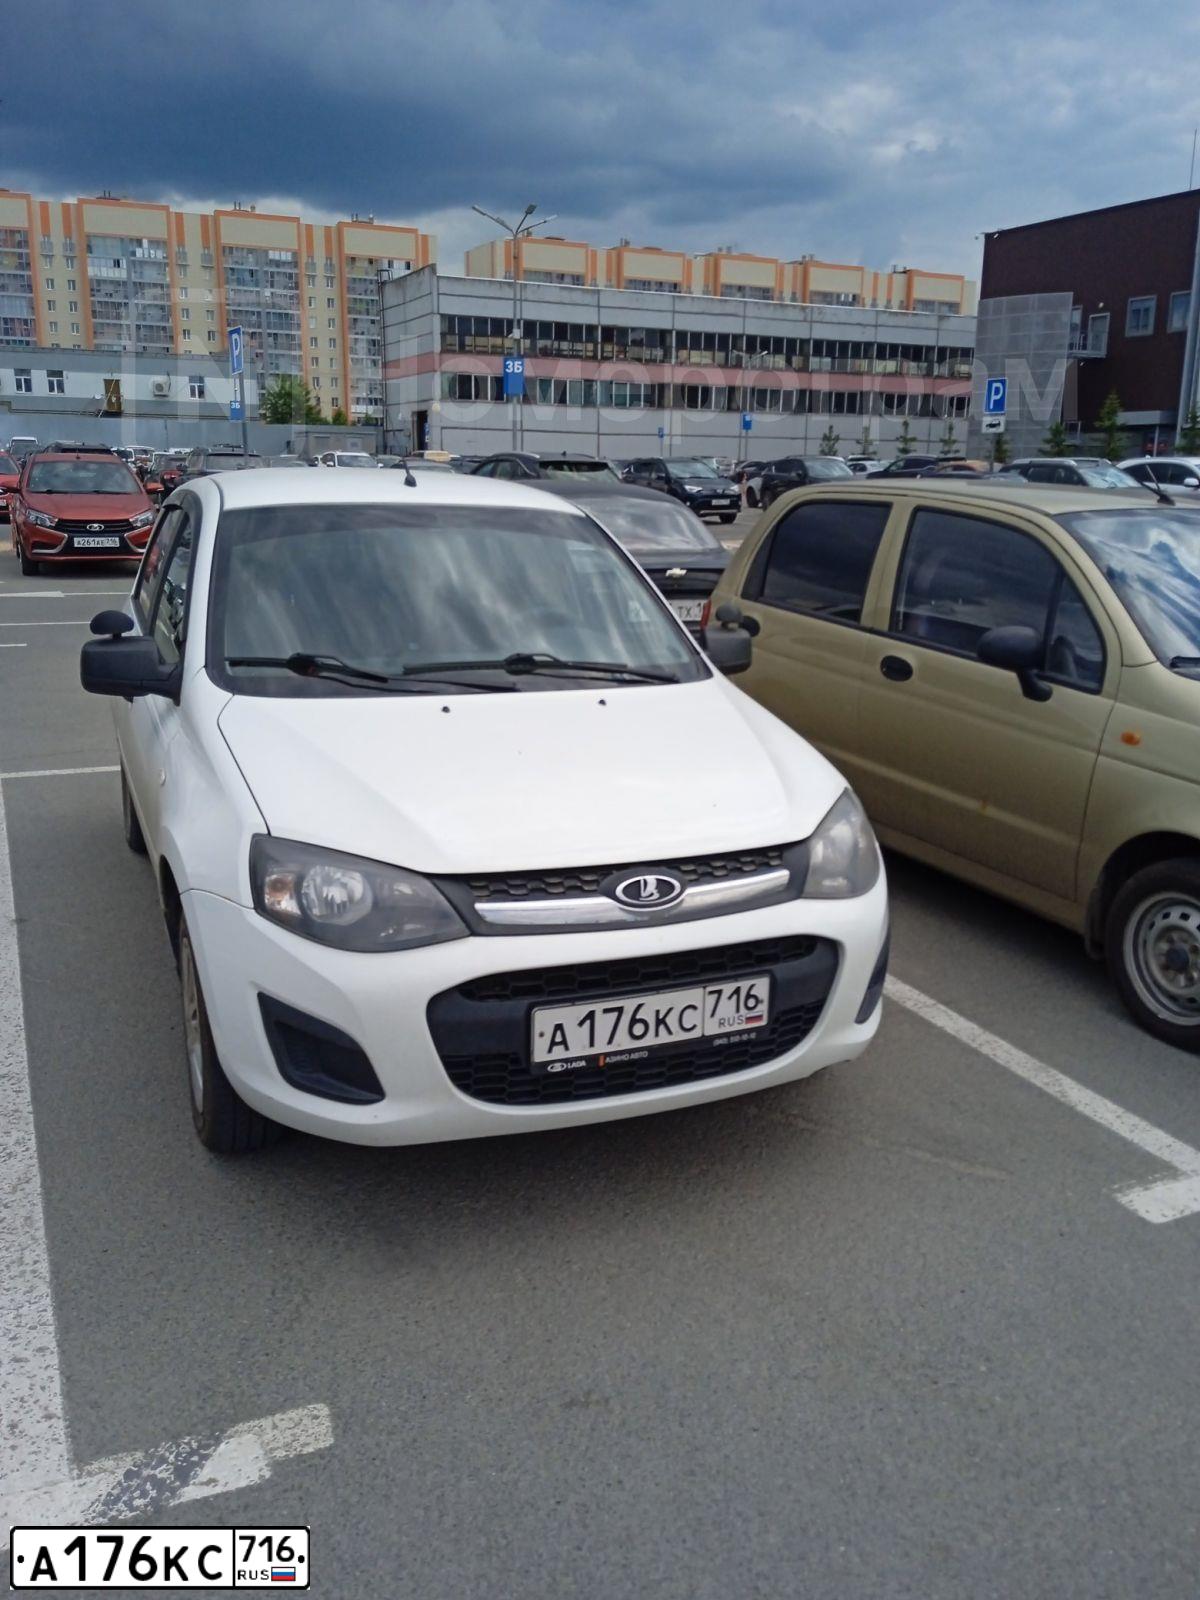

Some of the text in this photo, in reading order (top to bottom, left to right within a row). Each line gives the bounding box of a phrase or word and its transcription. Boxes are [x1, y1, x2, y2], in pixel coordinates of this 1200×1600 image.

[990, 382, 1003, 409] P
[547, 984, 759, 1054] А176КС 716
[718, 1015, 744, 1028] RUS
[567, 1060, 586, 1069] LADA
